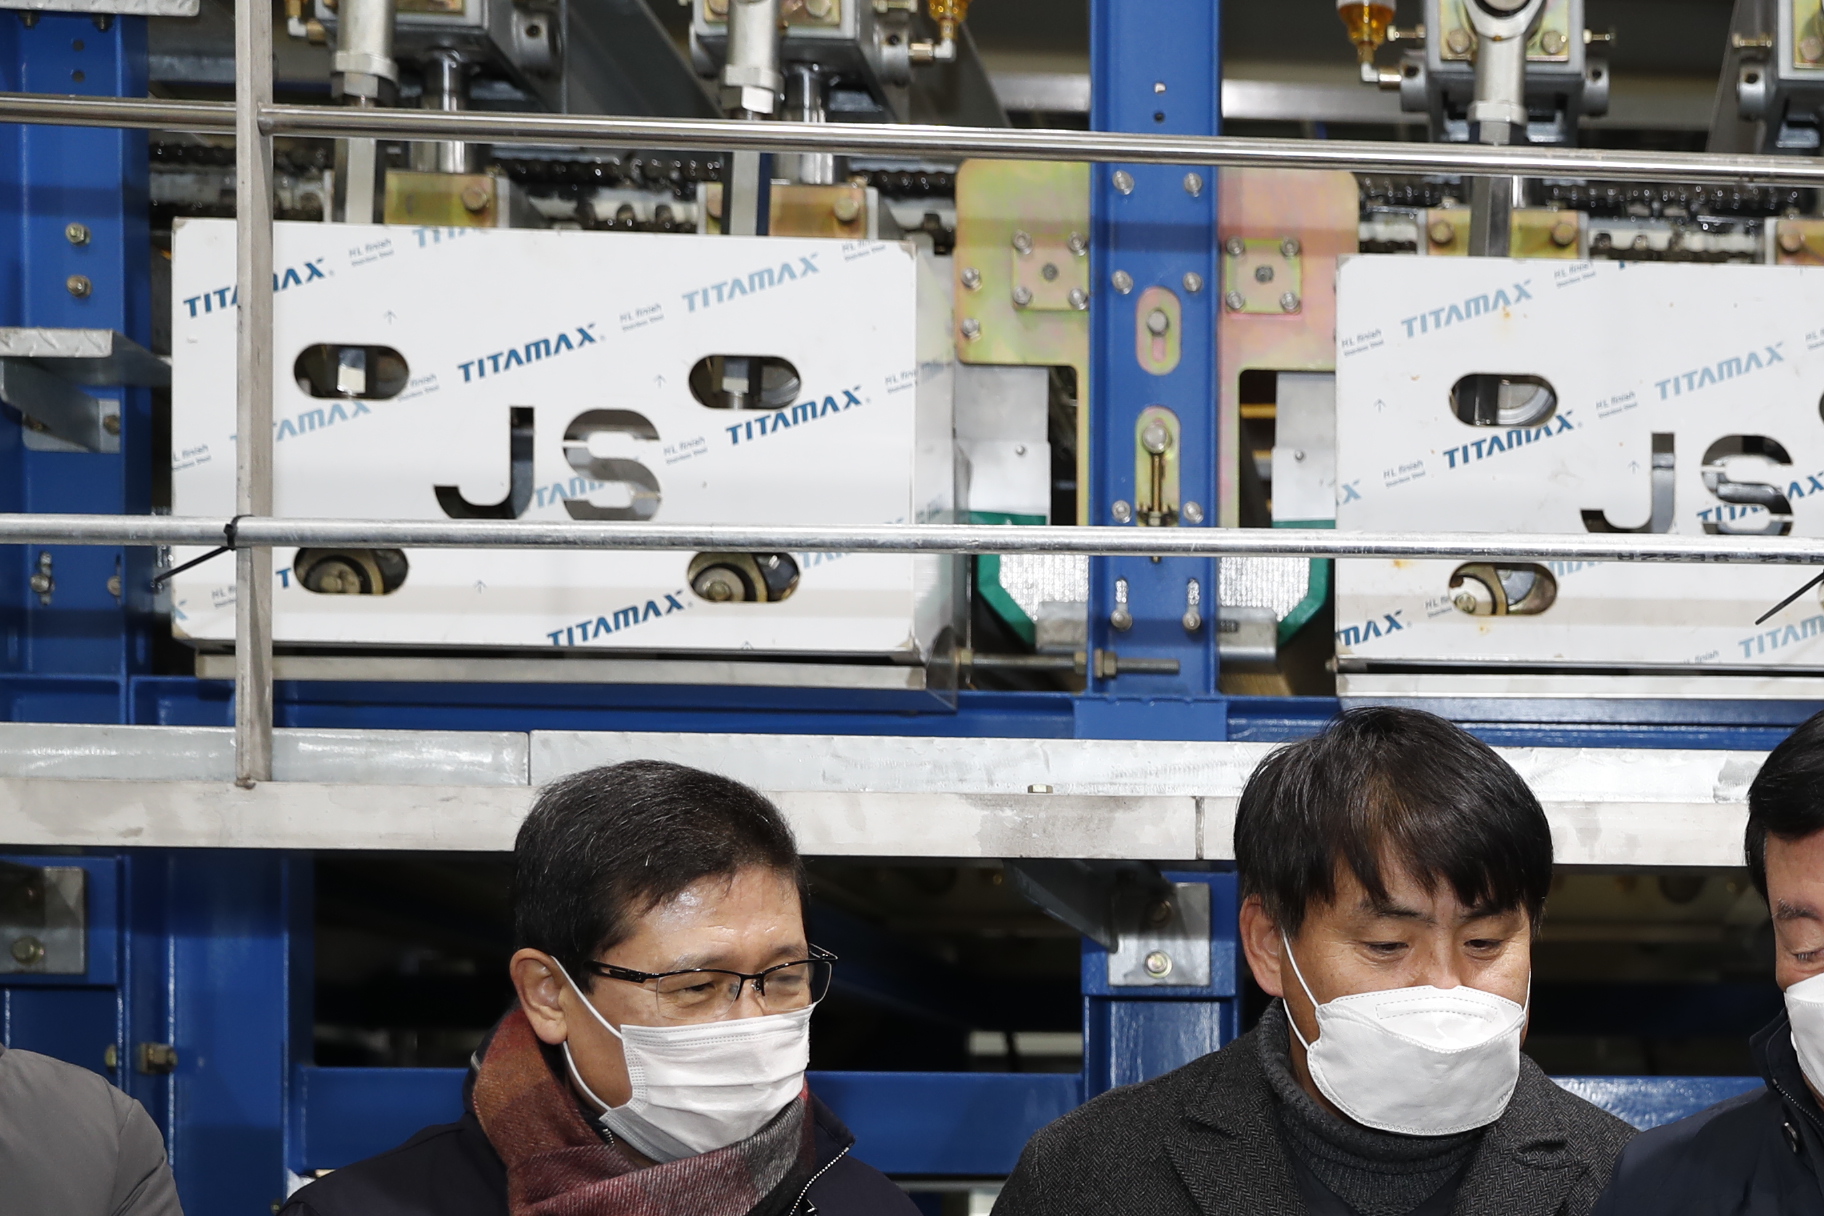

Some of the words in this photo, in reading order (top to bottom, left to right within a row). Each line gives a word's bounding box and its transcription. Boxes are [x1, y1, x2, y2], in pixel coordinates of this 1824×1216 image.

[682, 253, 820, 313] TITAMAX
[1401, 279, 1533, 339] TITAMAX
[457, 323, 596, 383] TITAMAX
[1655, 341, 1784, 401] TITAMAX
[726, 385, 862, 445] TITAMAX
[433, 406, 662, 521] JS
[1580, 432, 1793, 535] JS
[547, 590, 684, 646] TITAMAX
